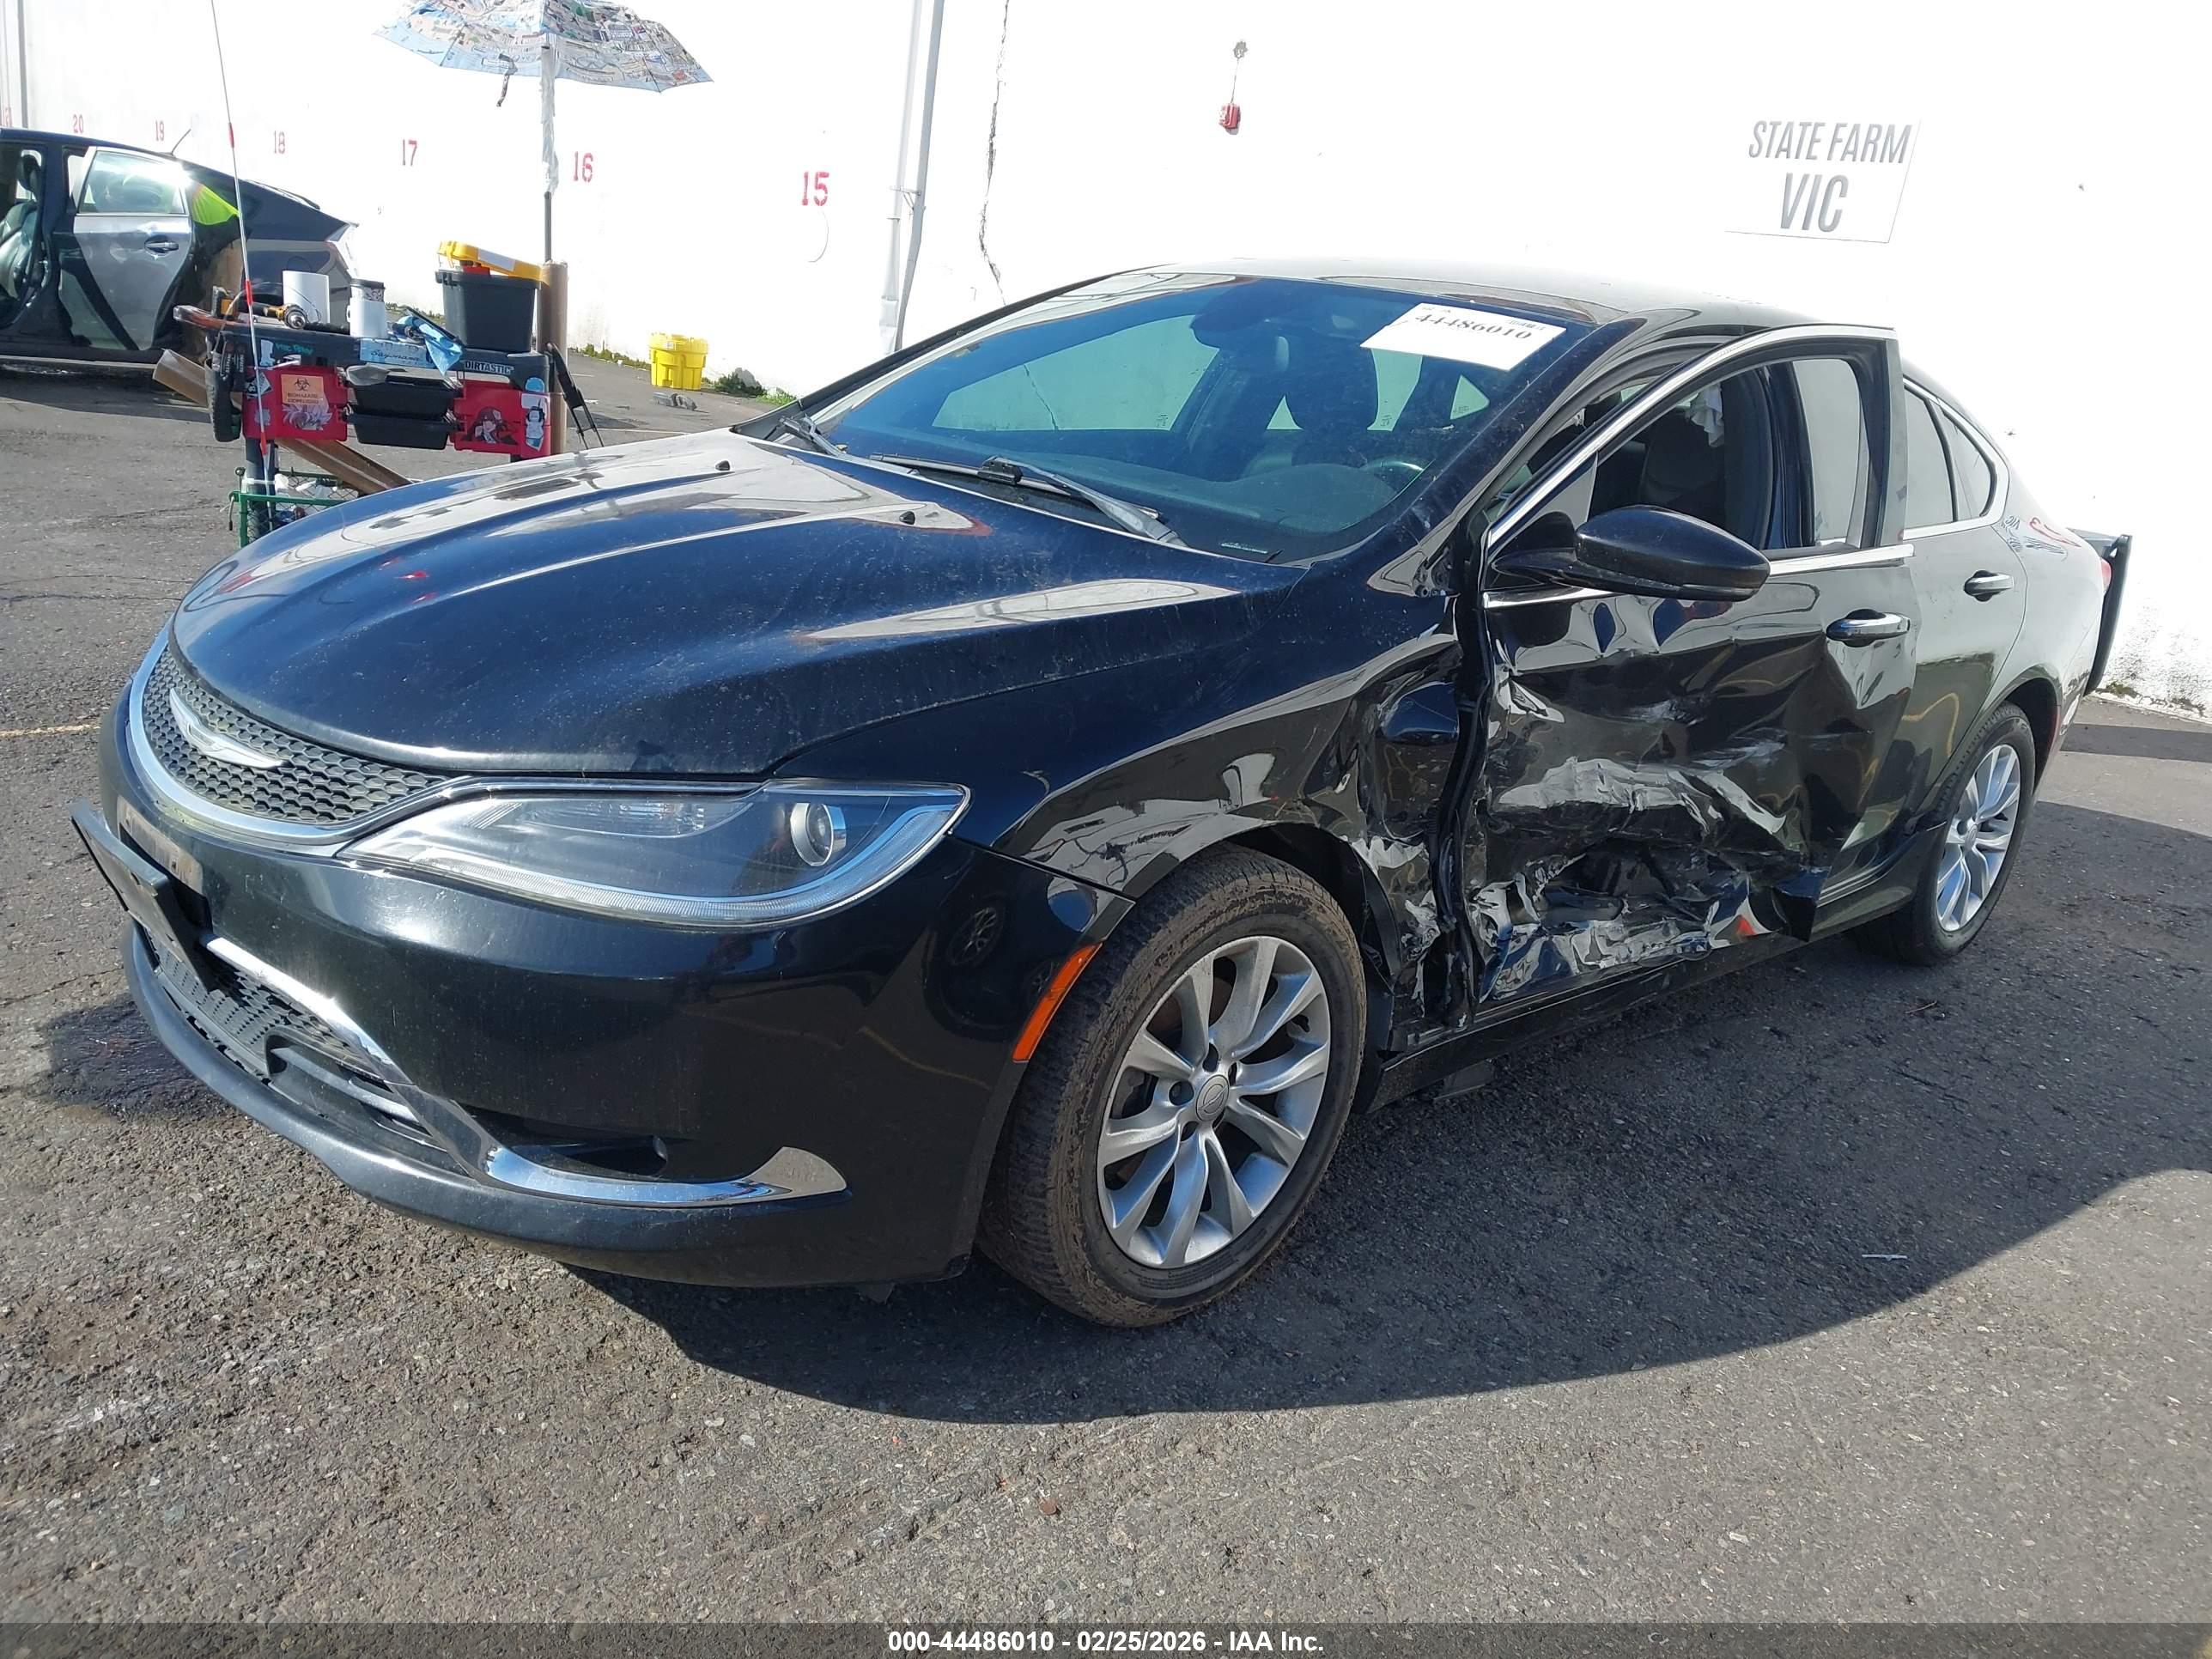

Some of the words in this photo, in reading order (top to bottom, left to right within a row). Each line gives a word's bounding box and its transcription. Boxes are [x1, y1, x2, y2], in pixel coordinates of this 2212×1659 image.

[72, 113, 84, 134] 20
[155, 120, 165, 142] 19
[273, 131, 286, 155] 18
[402, 139, 418, 167] 17
[1748, 119, 1826, 161] STATE
[1826, 122, 1913, 164] FARM
[573, 150, 594, 184] 16
[802, 171, 830, 207] 15
[1780, 172, 1850, 233] VIC
[1414, 313, 1533, 340] 44486010
[464, 361, 513, 375] DIRTASTIC
